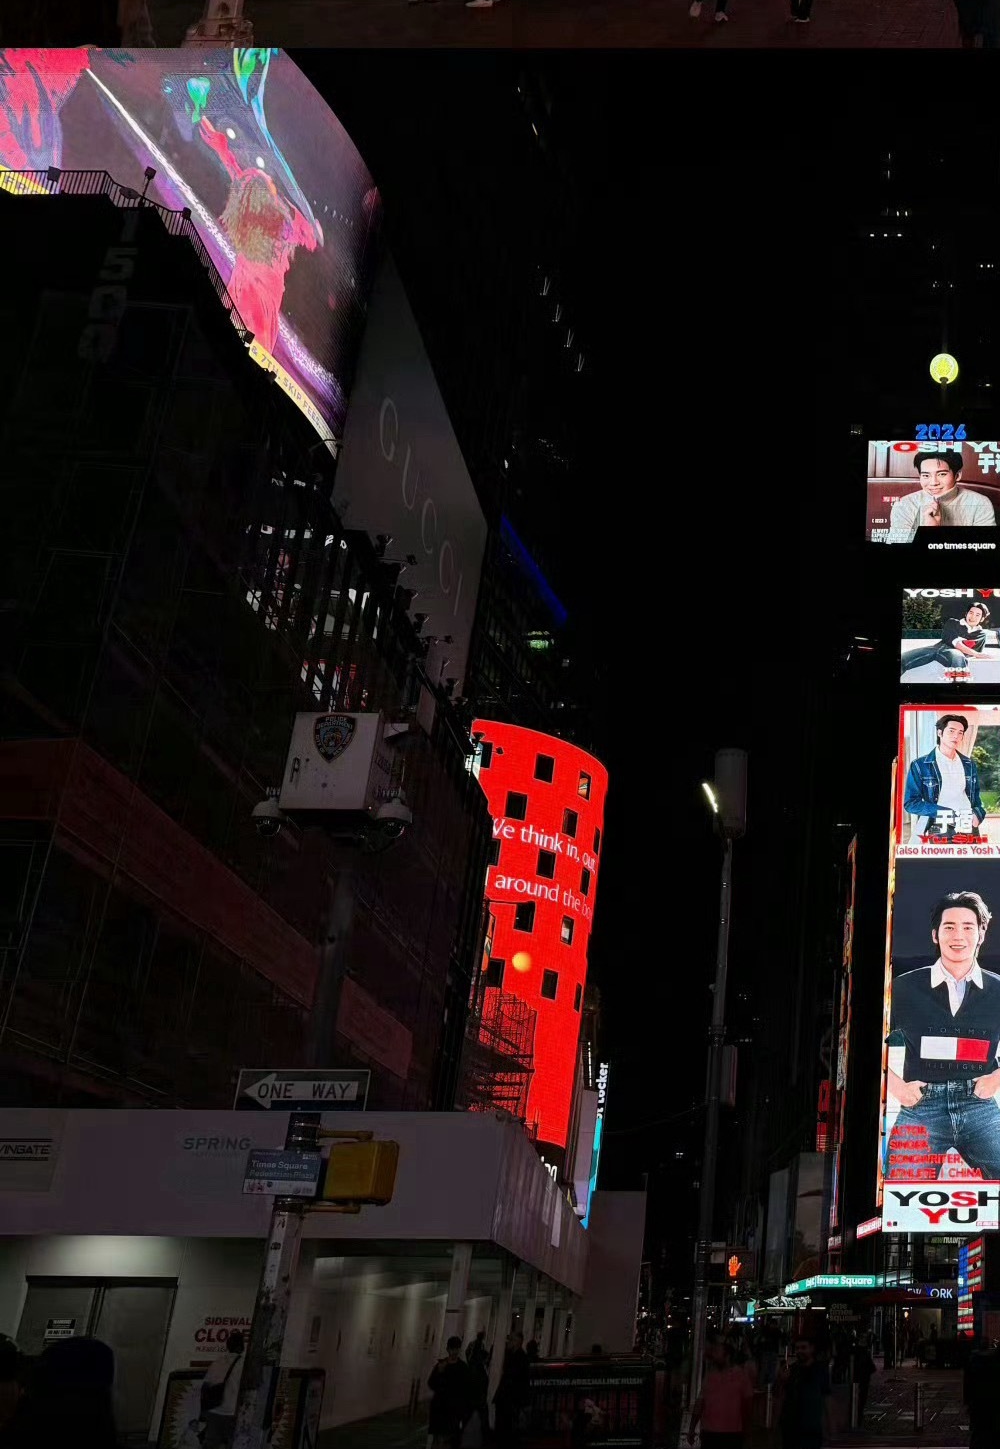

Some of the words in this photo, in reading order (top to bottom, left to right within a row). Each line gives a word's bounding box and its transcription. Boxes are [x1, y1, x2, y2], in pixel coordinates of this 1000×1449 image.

[283, 377, 302, 401] SKIP
[915, 423, 967, 440] 2026
[869, 440, 962, 453] YOSH
[380, 397, 463, 616] GUCCI
[967, 542, 996, 551] square
[904, 588, 974, 598] YOSH
[521, 824, 563, 852] think
[918, 834, 948, 844] Yu
[952, 833, 989, 844] Shi
[896, 845, 919, 855] (also
[921, 845, 955, 855] known
[957, 847, 968, 855] as
[969, 845, 993, 855] Yosh
[495, 874, 560, 902] around
[563, 888, 581, 912] the
[257, 1083, 294, 1099] ONE
[312, 1083, 350, 1099] WAY
[183, 1137, 250, 1151] SPRING
[251, 1159, 277, 1169] Times
[278, 1161, 308, 1170] Square
[948, 1167, 983, 1178] CHINA
[918, 1208, 978, 1224] YU
[841, 1276, 873, 1287] Square
[204, 1317, 252, 1326] SIDEWAL
